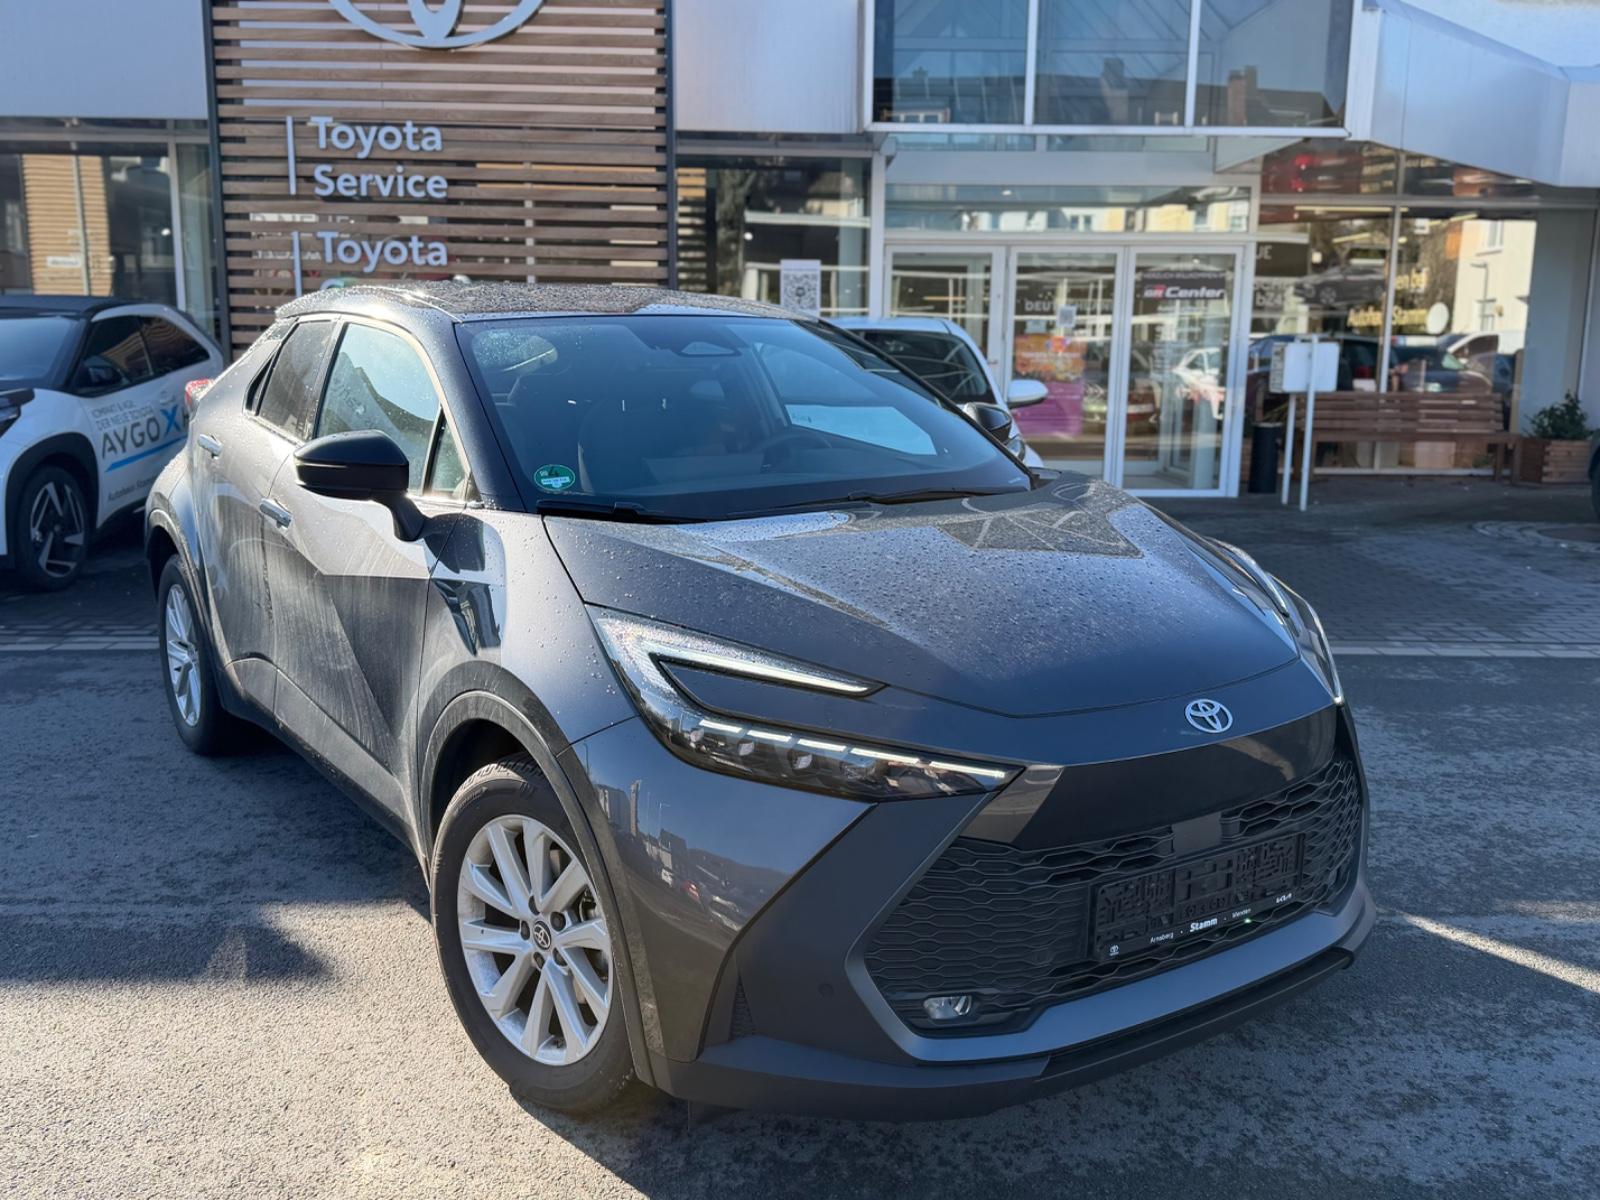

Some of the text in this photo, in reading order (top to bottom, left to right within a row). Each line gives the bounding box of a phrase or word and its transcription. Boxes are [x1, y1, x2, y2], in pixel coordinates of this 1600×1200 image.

[310, 116, 443, 159] Toyota
[313, 163, 448, 198] Service
[316, 231, 448, 273] Toyota
[1165, 286, 1225, 299] Center
[102, 416, 160, 459] AYGO
[160, 404, 182, 437] X
[1150, 931, 1174, 943] Arnsberg
[1190, 918, 1218, 932] Stamm
